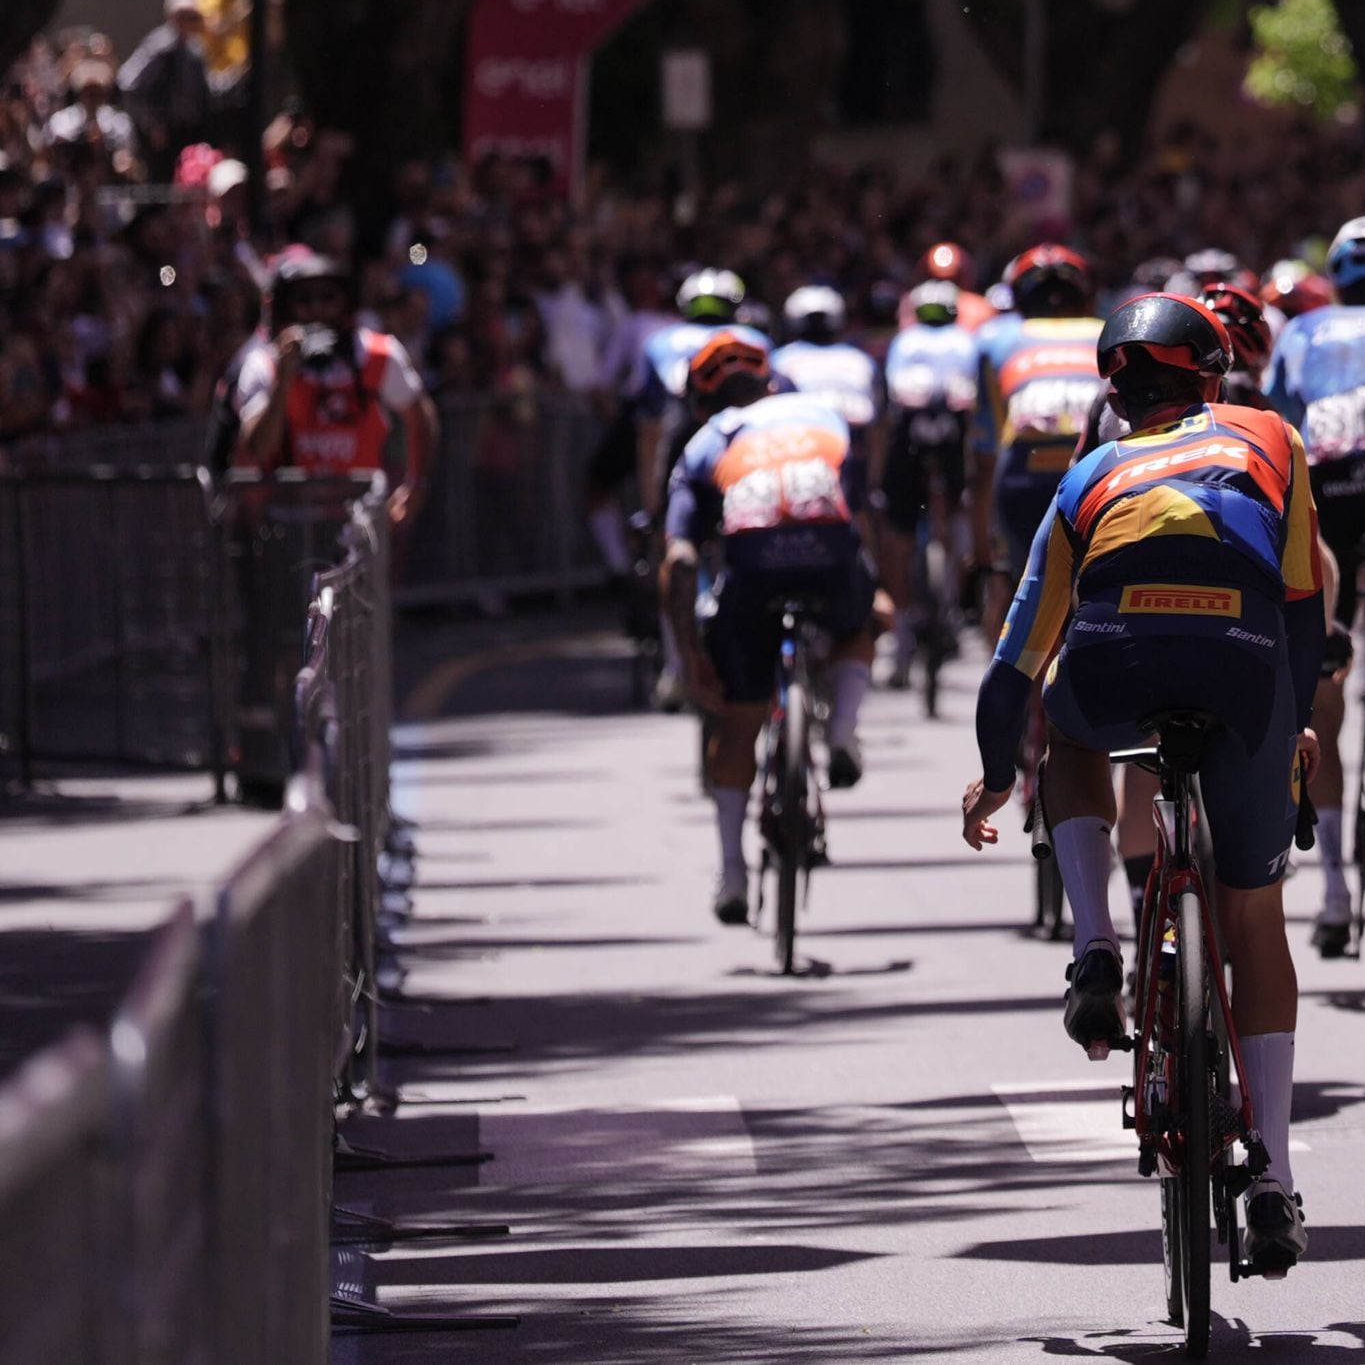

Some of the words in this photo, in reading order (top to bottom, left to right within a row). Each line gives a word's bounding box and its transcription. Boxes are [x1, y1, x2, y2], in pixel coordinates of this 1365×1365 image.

[1107, 443, 1249, 490] TREK
[1129, 590, 1231, 611] PIRELLI
[1074, 620, 1127, 634] Santini
[1226, 626, 1276, 648] Santini
